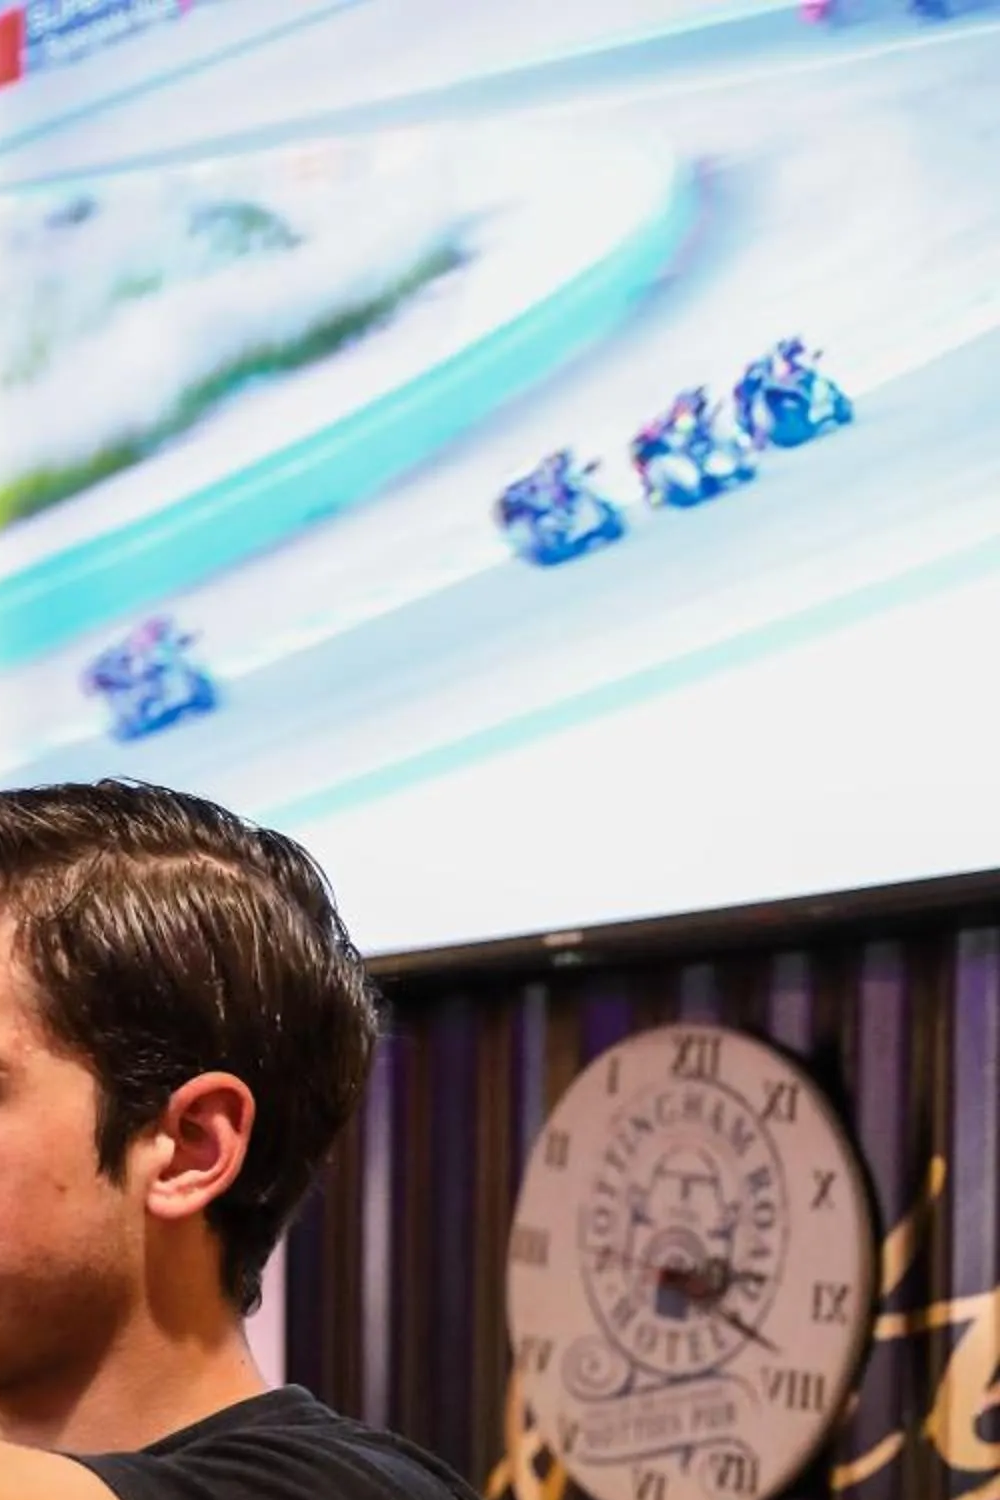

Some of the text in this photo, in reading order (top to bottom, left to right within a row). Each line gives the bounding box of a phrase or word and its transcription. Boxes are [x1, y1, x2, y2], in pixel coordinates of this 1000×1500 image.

[671, 1034, 721, 1080] XII
[763, 1080, 798, 1123] XI
[810, 1170, 837, 1210] X
[812, 1282, 851, 1325] IX
[611, 1295, 728, 1365] HOTEL
[760, 1366, 826, 1412] VIII
